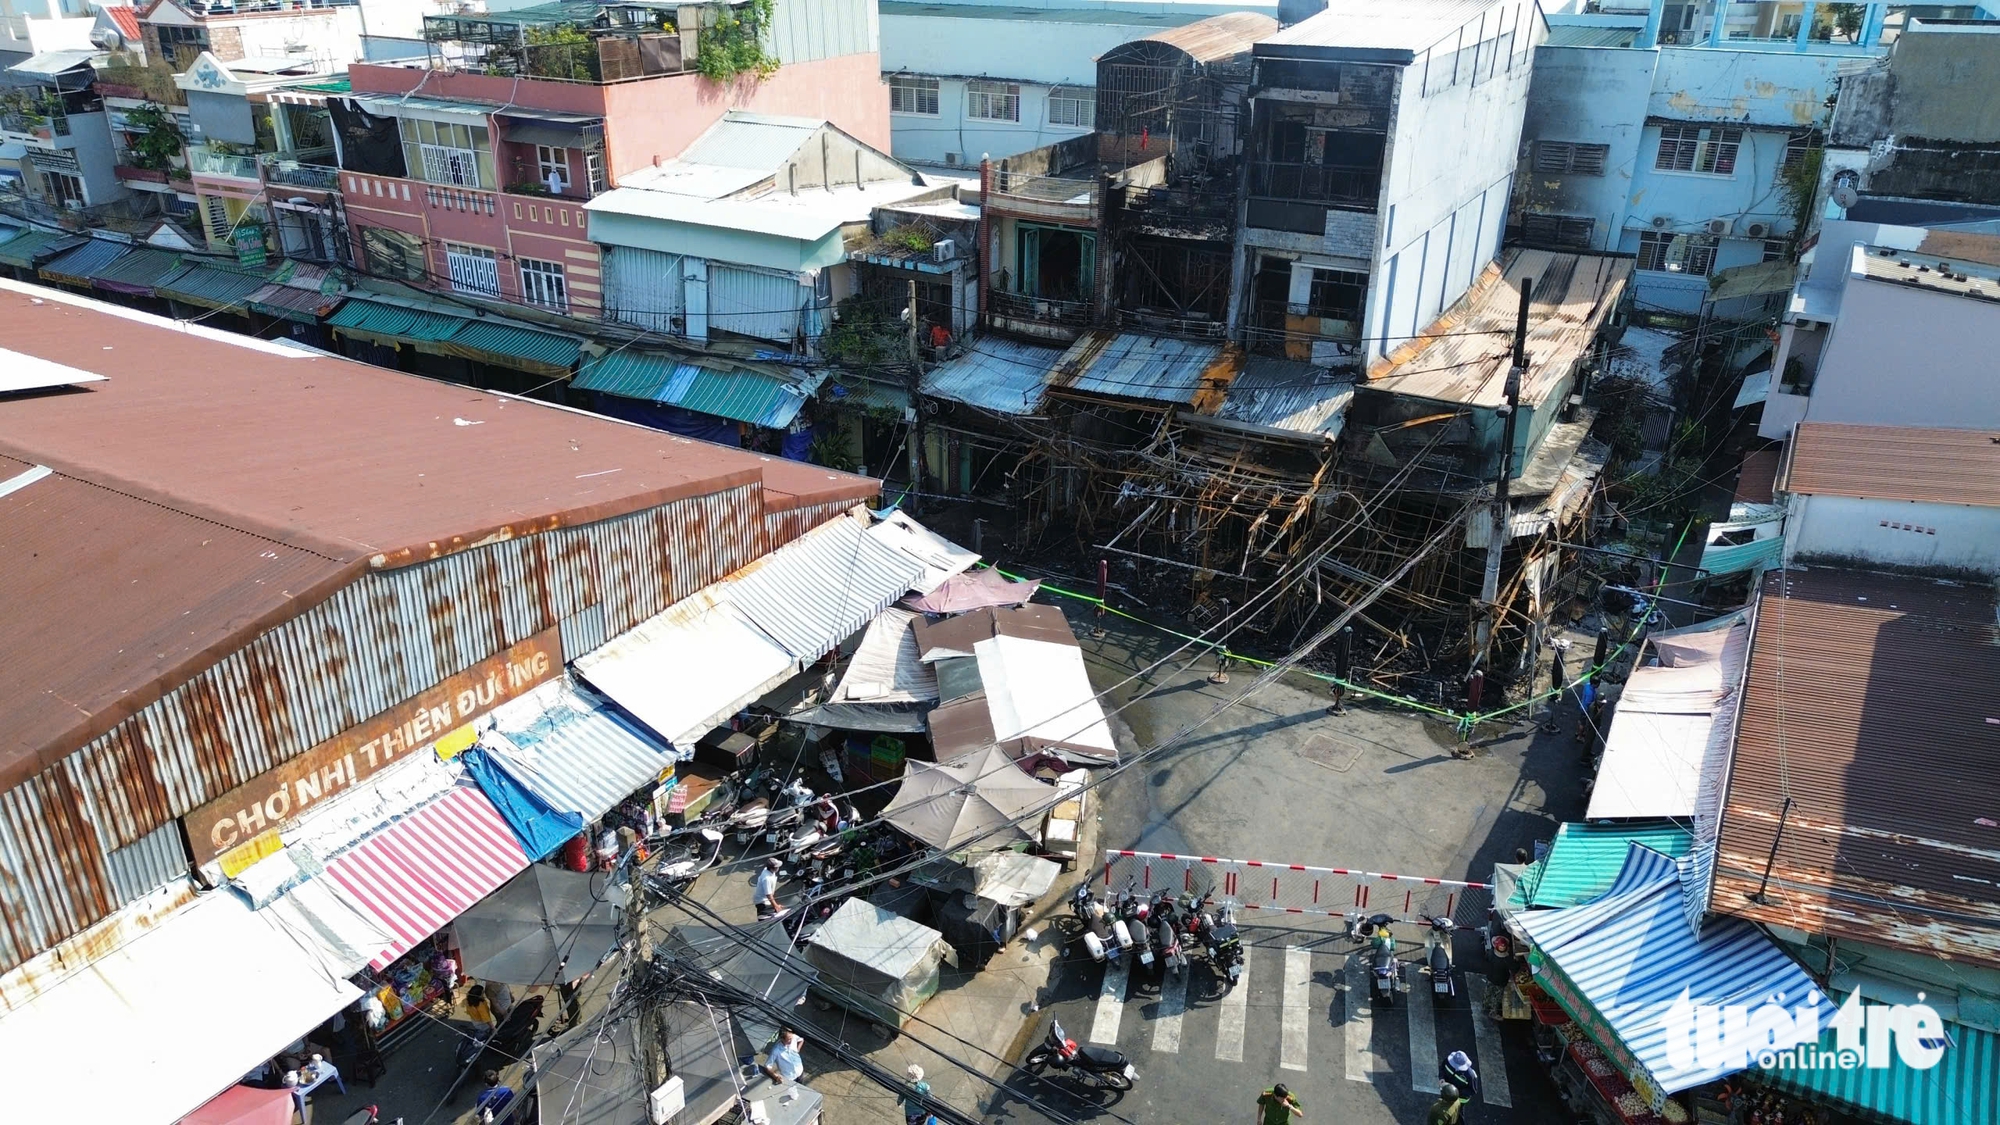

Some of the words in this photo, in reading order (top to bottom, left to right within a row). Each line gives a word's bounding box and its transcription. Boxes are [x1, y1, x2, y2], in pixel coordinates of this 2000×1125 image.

[211, 783, 290, 848] CHỢ
[295, 753, 357, 806] NHỊ
[360, 701, 452, 768] THIÊN
